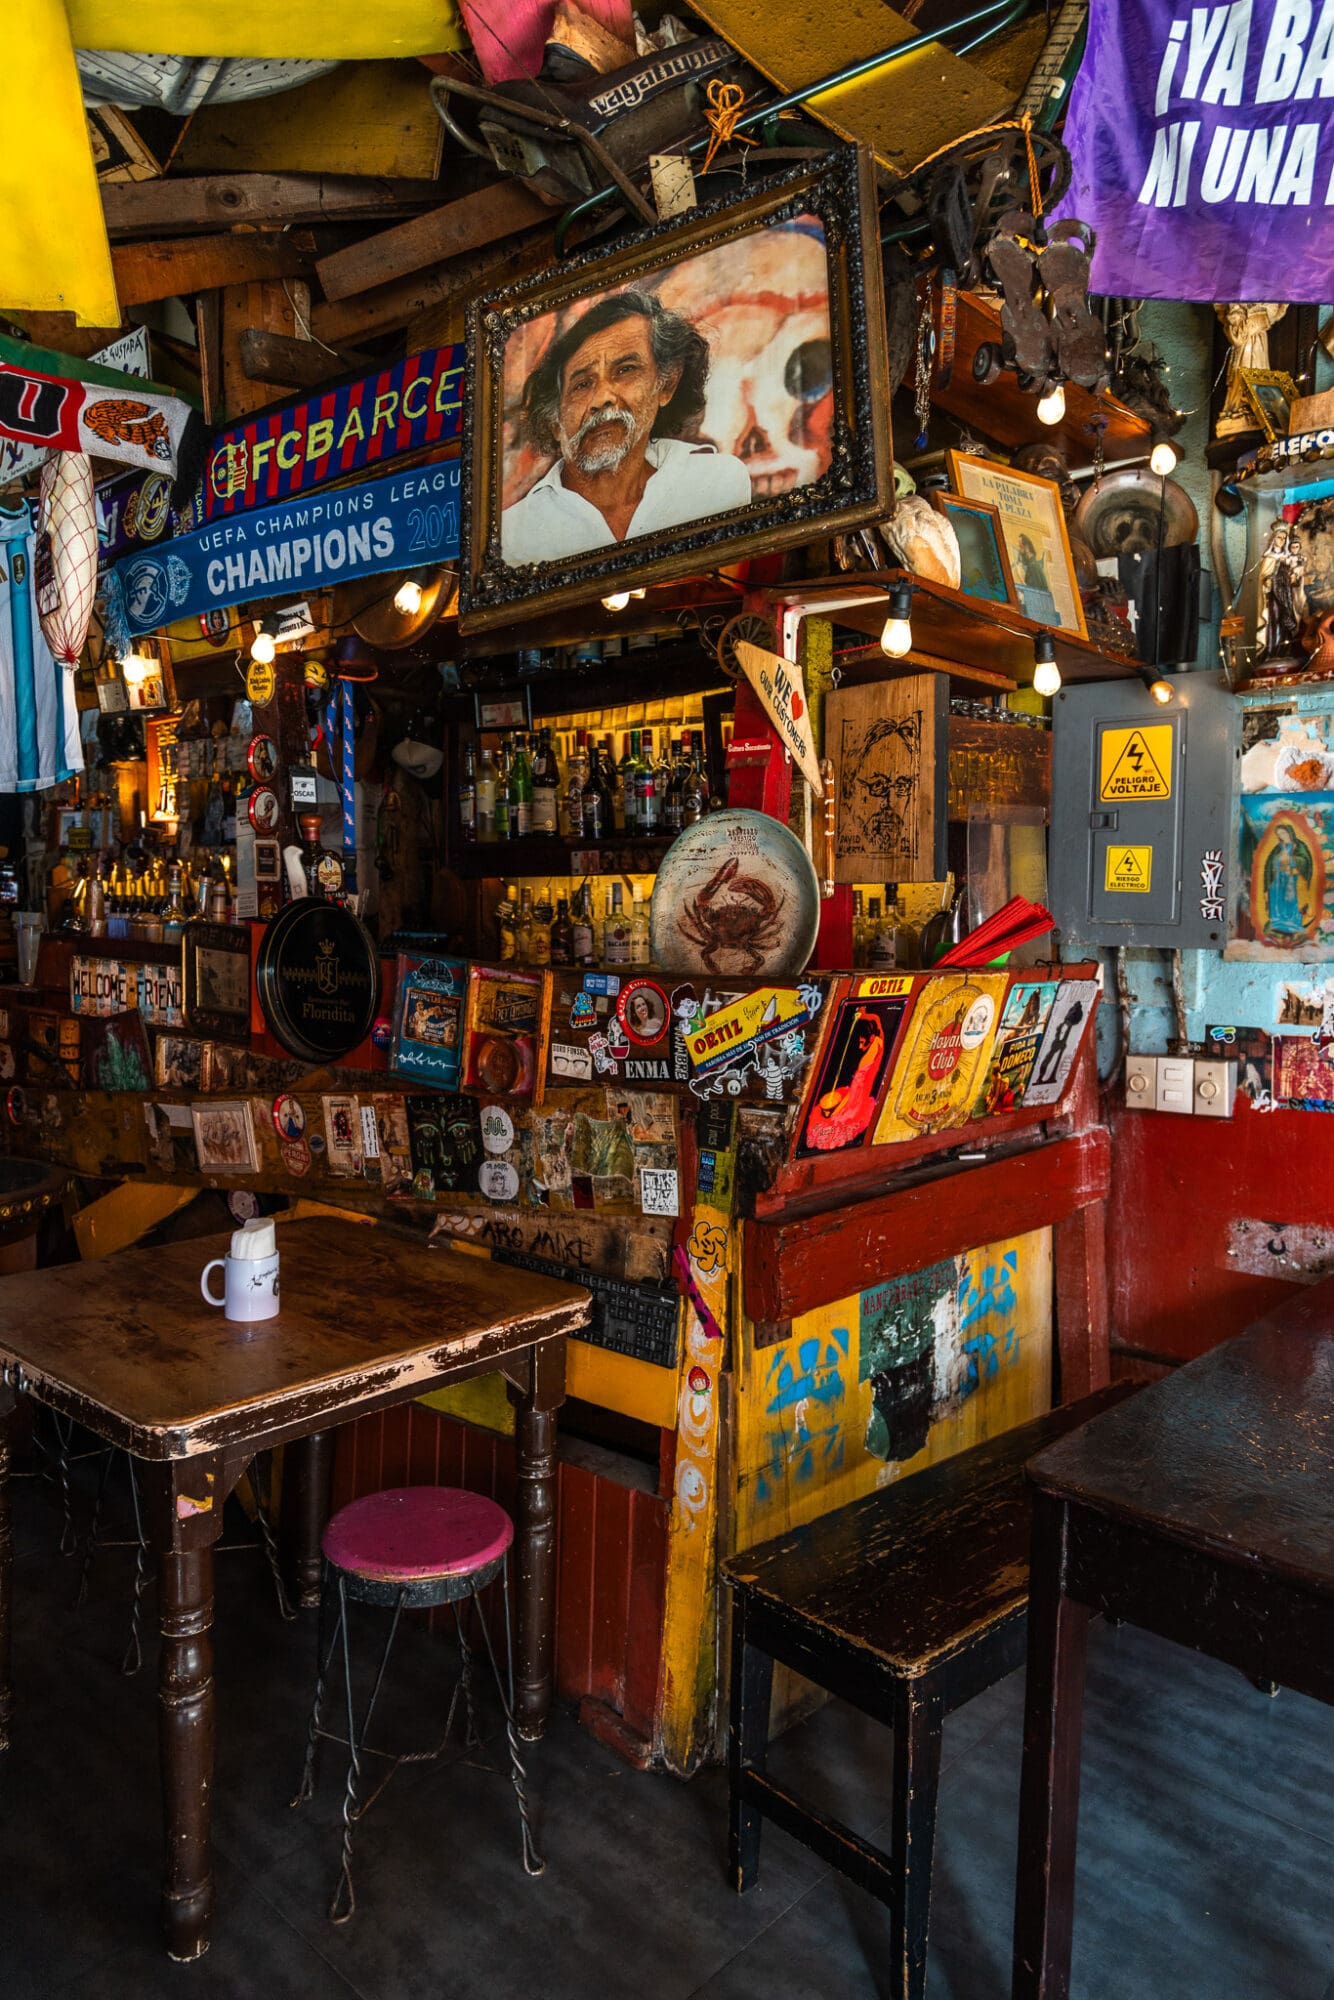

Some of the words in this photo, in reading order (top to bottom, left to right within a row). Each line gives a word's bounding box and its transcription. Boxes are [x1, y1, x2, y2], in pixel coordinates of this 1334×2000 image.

[1155, 0, 1253, 117] ¡YA
[1137, 121, 1201, 208] NI
[1200, 123, 1320, 206] UNA
[199, 526, 247, 552] UEFA
[255, 493, 374, 537] CHAMPIONS
[207, 516, 396, 597] CHAMPIONS
[774, 663, 792, 708] WE
[760, 670, 774, 699] OUR
[773, 695, 807, 759] CUSTOMERS
[293, 790, 315, 798] OSCAR
[1110, 783, 1161, 794] VOLTAJE
[1115, 776, 1155, 785] PELIGRO
[73, 970, 127, 1006] WELCOME
[869, 978, 904, 995] ORTIZ
[693, 1018, 743, 1055] ORTIZ
[624, 1060, 670, 1079] ENMA
[930, 1050, 955, 1071] Club
[930, 1089, 938, 1105] 3
[530, 1229, 593, 1269] MIKE
